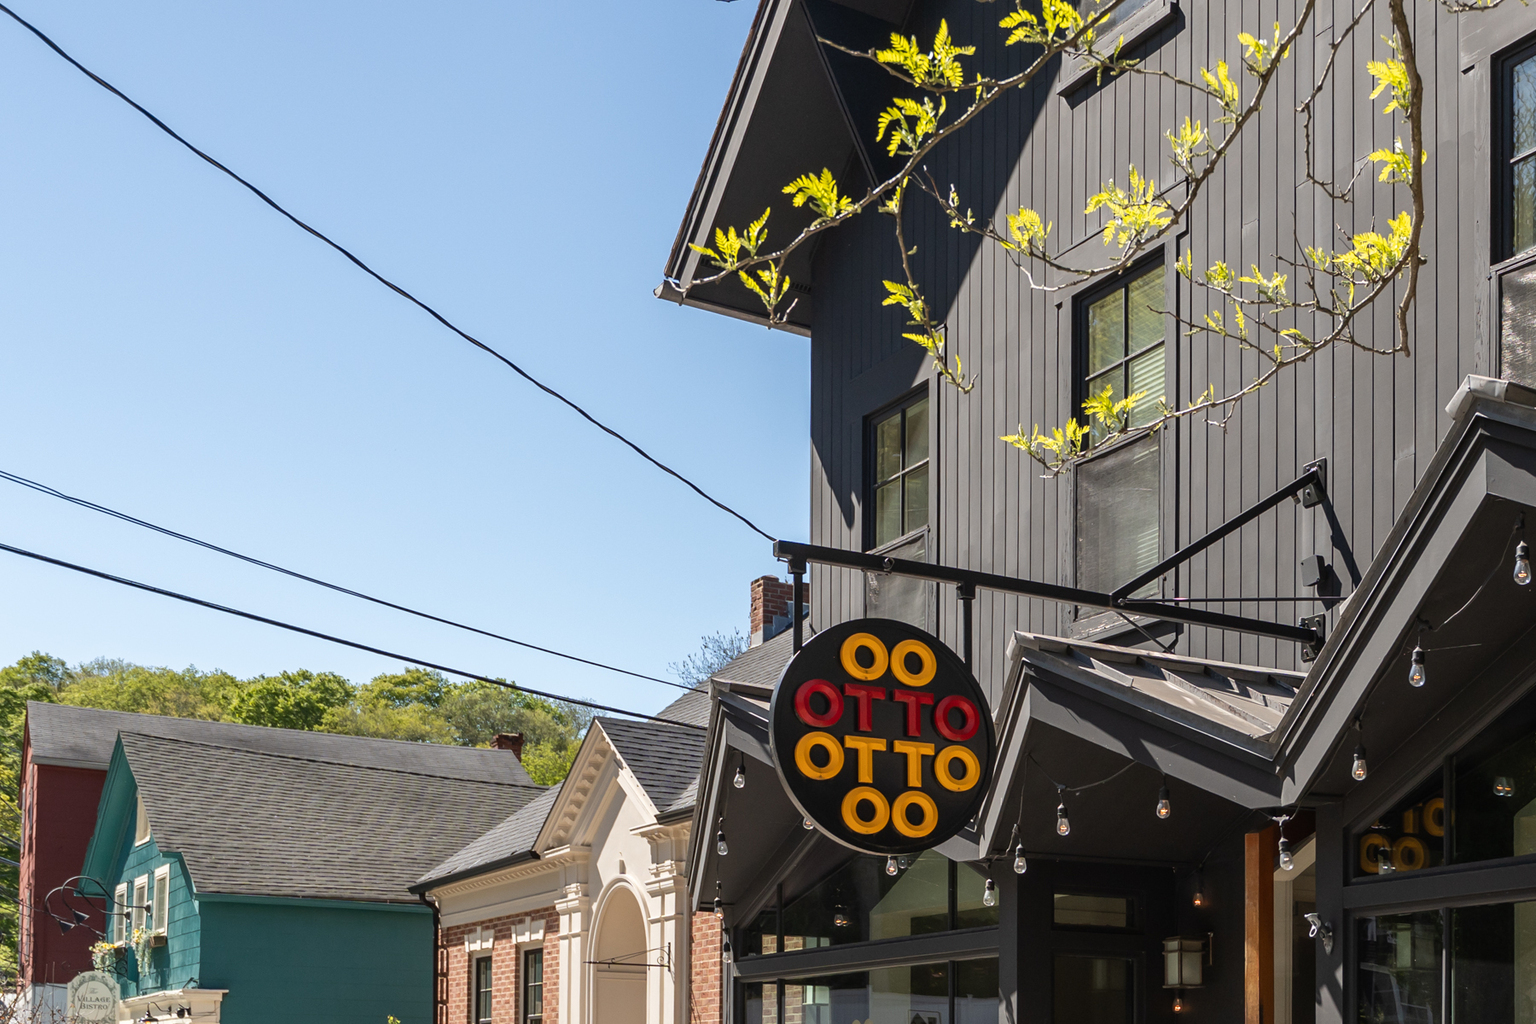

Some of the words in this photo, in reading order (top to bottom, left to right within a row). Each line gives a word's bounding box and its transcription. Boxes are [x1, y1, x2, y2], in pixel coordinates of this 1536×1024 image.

[840, 632, 937, 687] OO
[794, 679, 980, 741] OTTO
[794, 731, 981, 792] OTTO
[841, 786, 938, 838] OO
[77, 995, 111, 1003] VILLAGE
